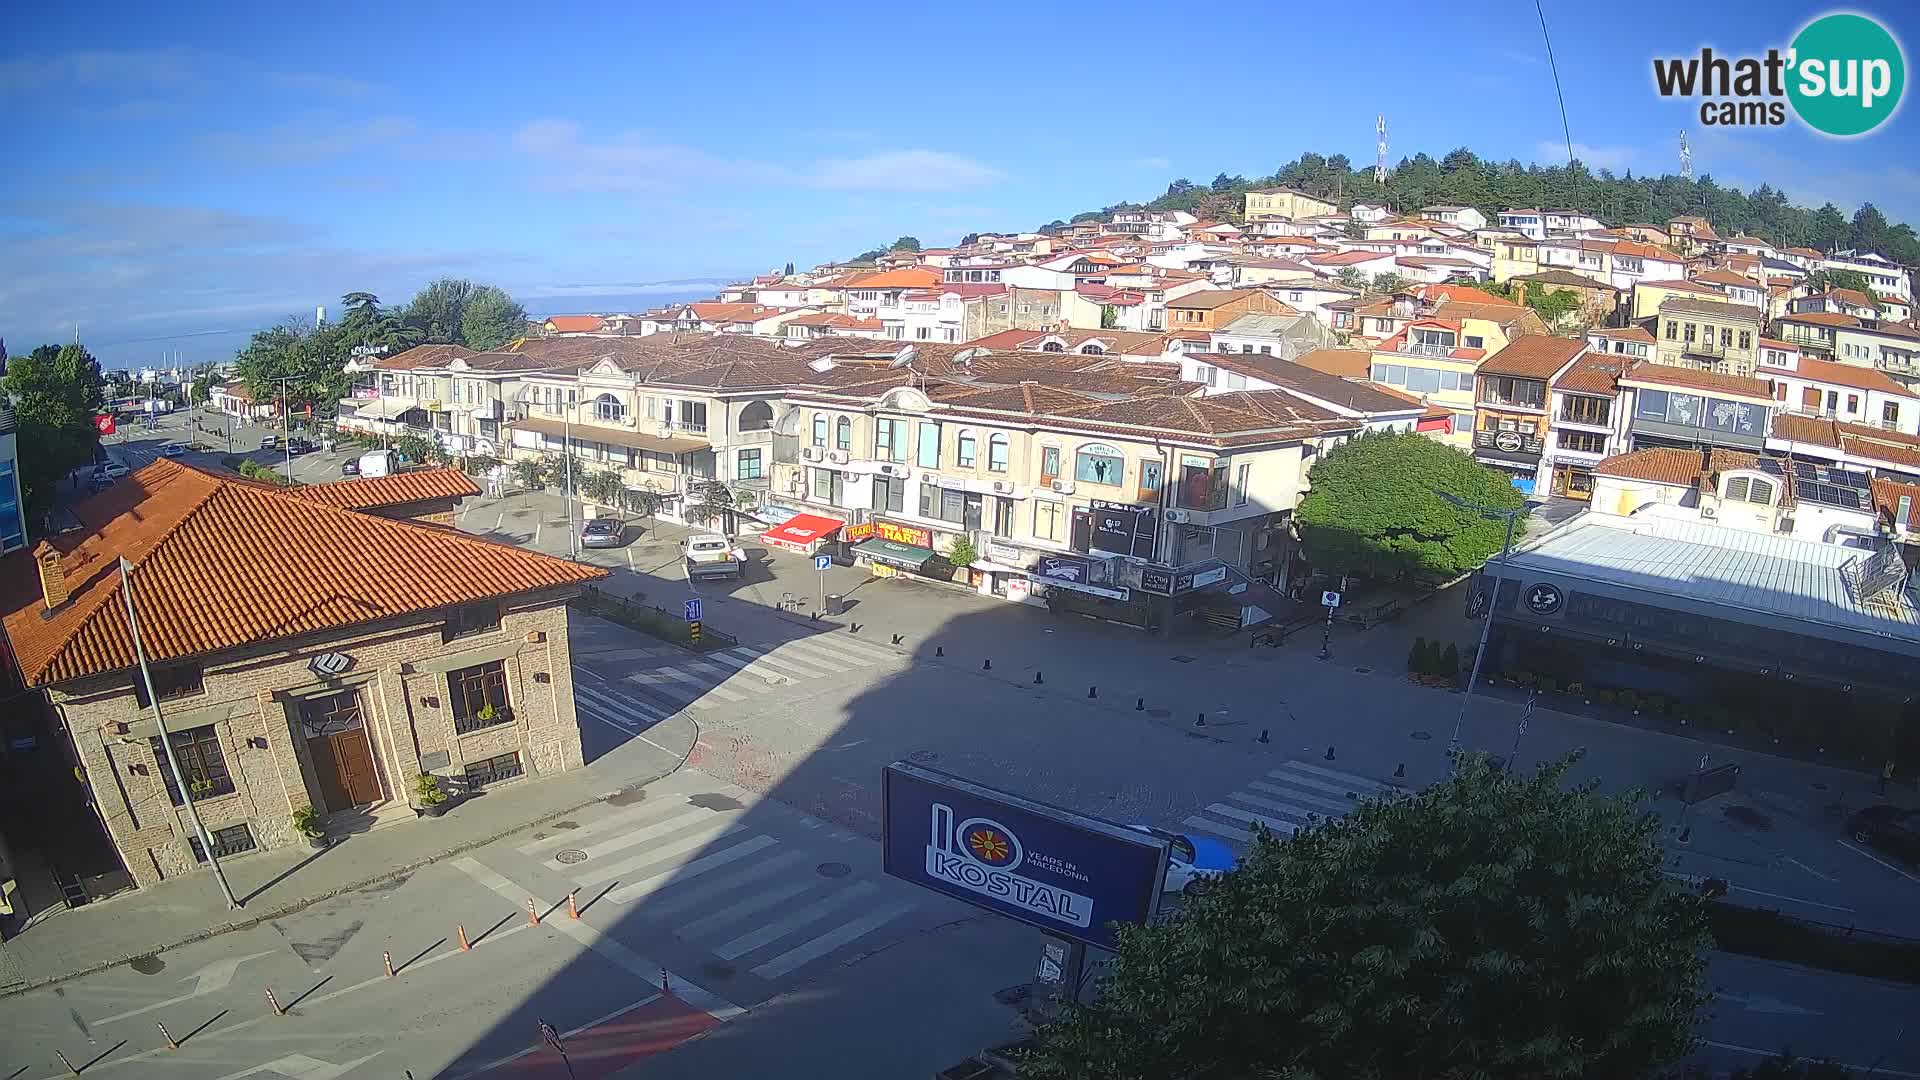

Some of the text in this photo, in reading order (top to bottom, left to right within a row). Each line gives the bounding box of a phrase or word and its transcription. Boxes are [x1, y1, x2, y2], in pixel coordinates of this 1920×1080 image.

[1027, 857, 1089, 883] MACEDONIA
[1028, 849, 1077, 871] YEARS IN
[935, 853, 1082, 922] KOSTAL
